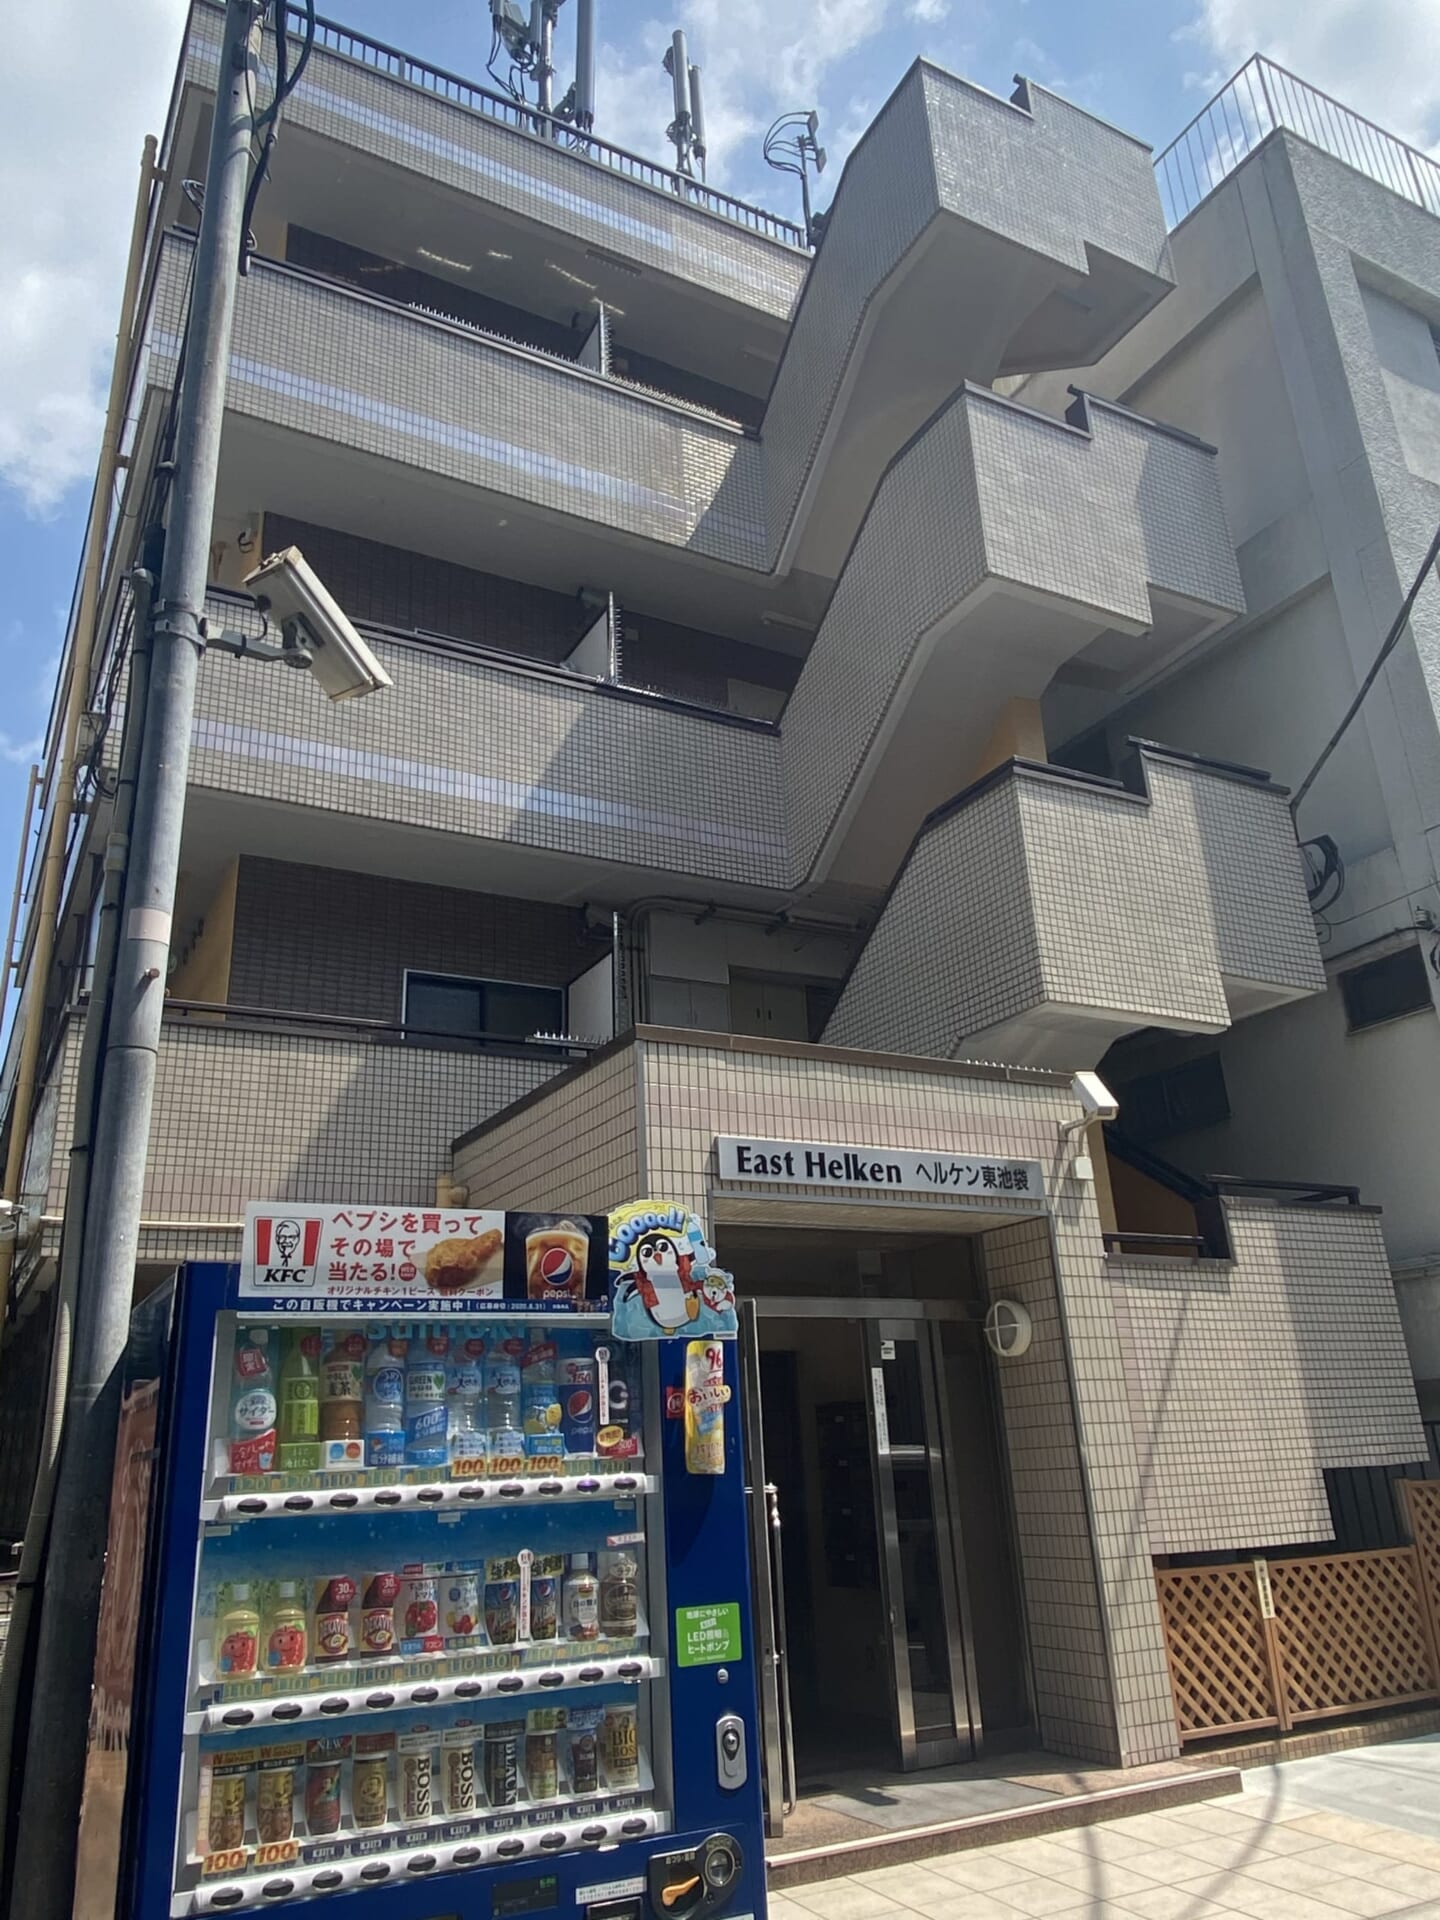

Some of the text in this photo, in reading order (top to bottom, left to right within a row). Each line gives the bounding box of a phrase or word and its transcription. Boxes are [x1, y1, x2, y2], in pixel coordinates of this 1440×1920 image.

[736, 1145, 903, 1183] East Helken
[915, 1161, 1030, 1191] ヘルケン東池袋
[331, 1211, 484, 1235] ペプシを買って
[329, 1237, 417, 1258] その場で
[263, 1268, 307, 1283] KFC
[688, 1387, 730, 1404] おいしい
[454, 1459, 484, 1475] 100
[491, 1457, 521, 1473] 100
[530, 1455, 559, 1470] 100
[687, 1641, 730, 1655] ヒートポンプ
[460, 1751, 474, 1809] BOSS
[504, 1743, 518, 1804] BLACK
[416, 1758, 431, 1816] BOSS
[207, 1851, 244, 1871] 100
[257, 1844, 296, 1863] 100
